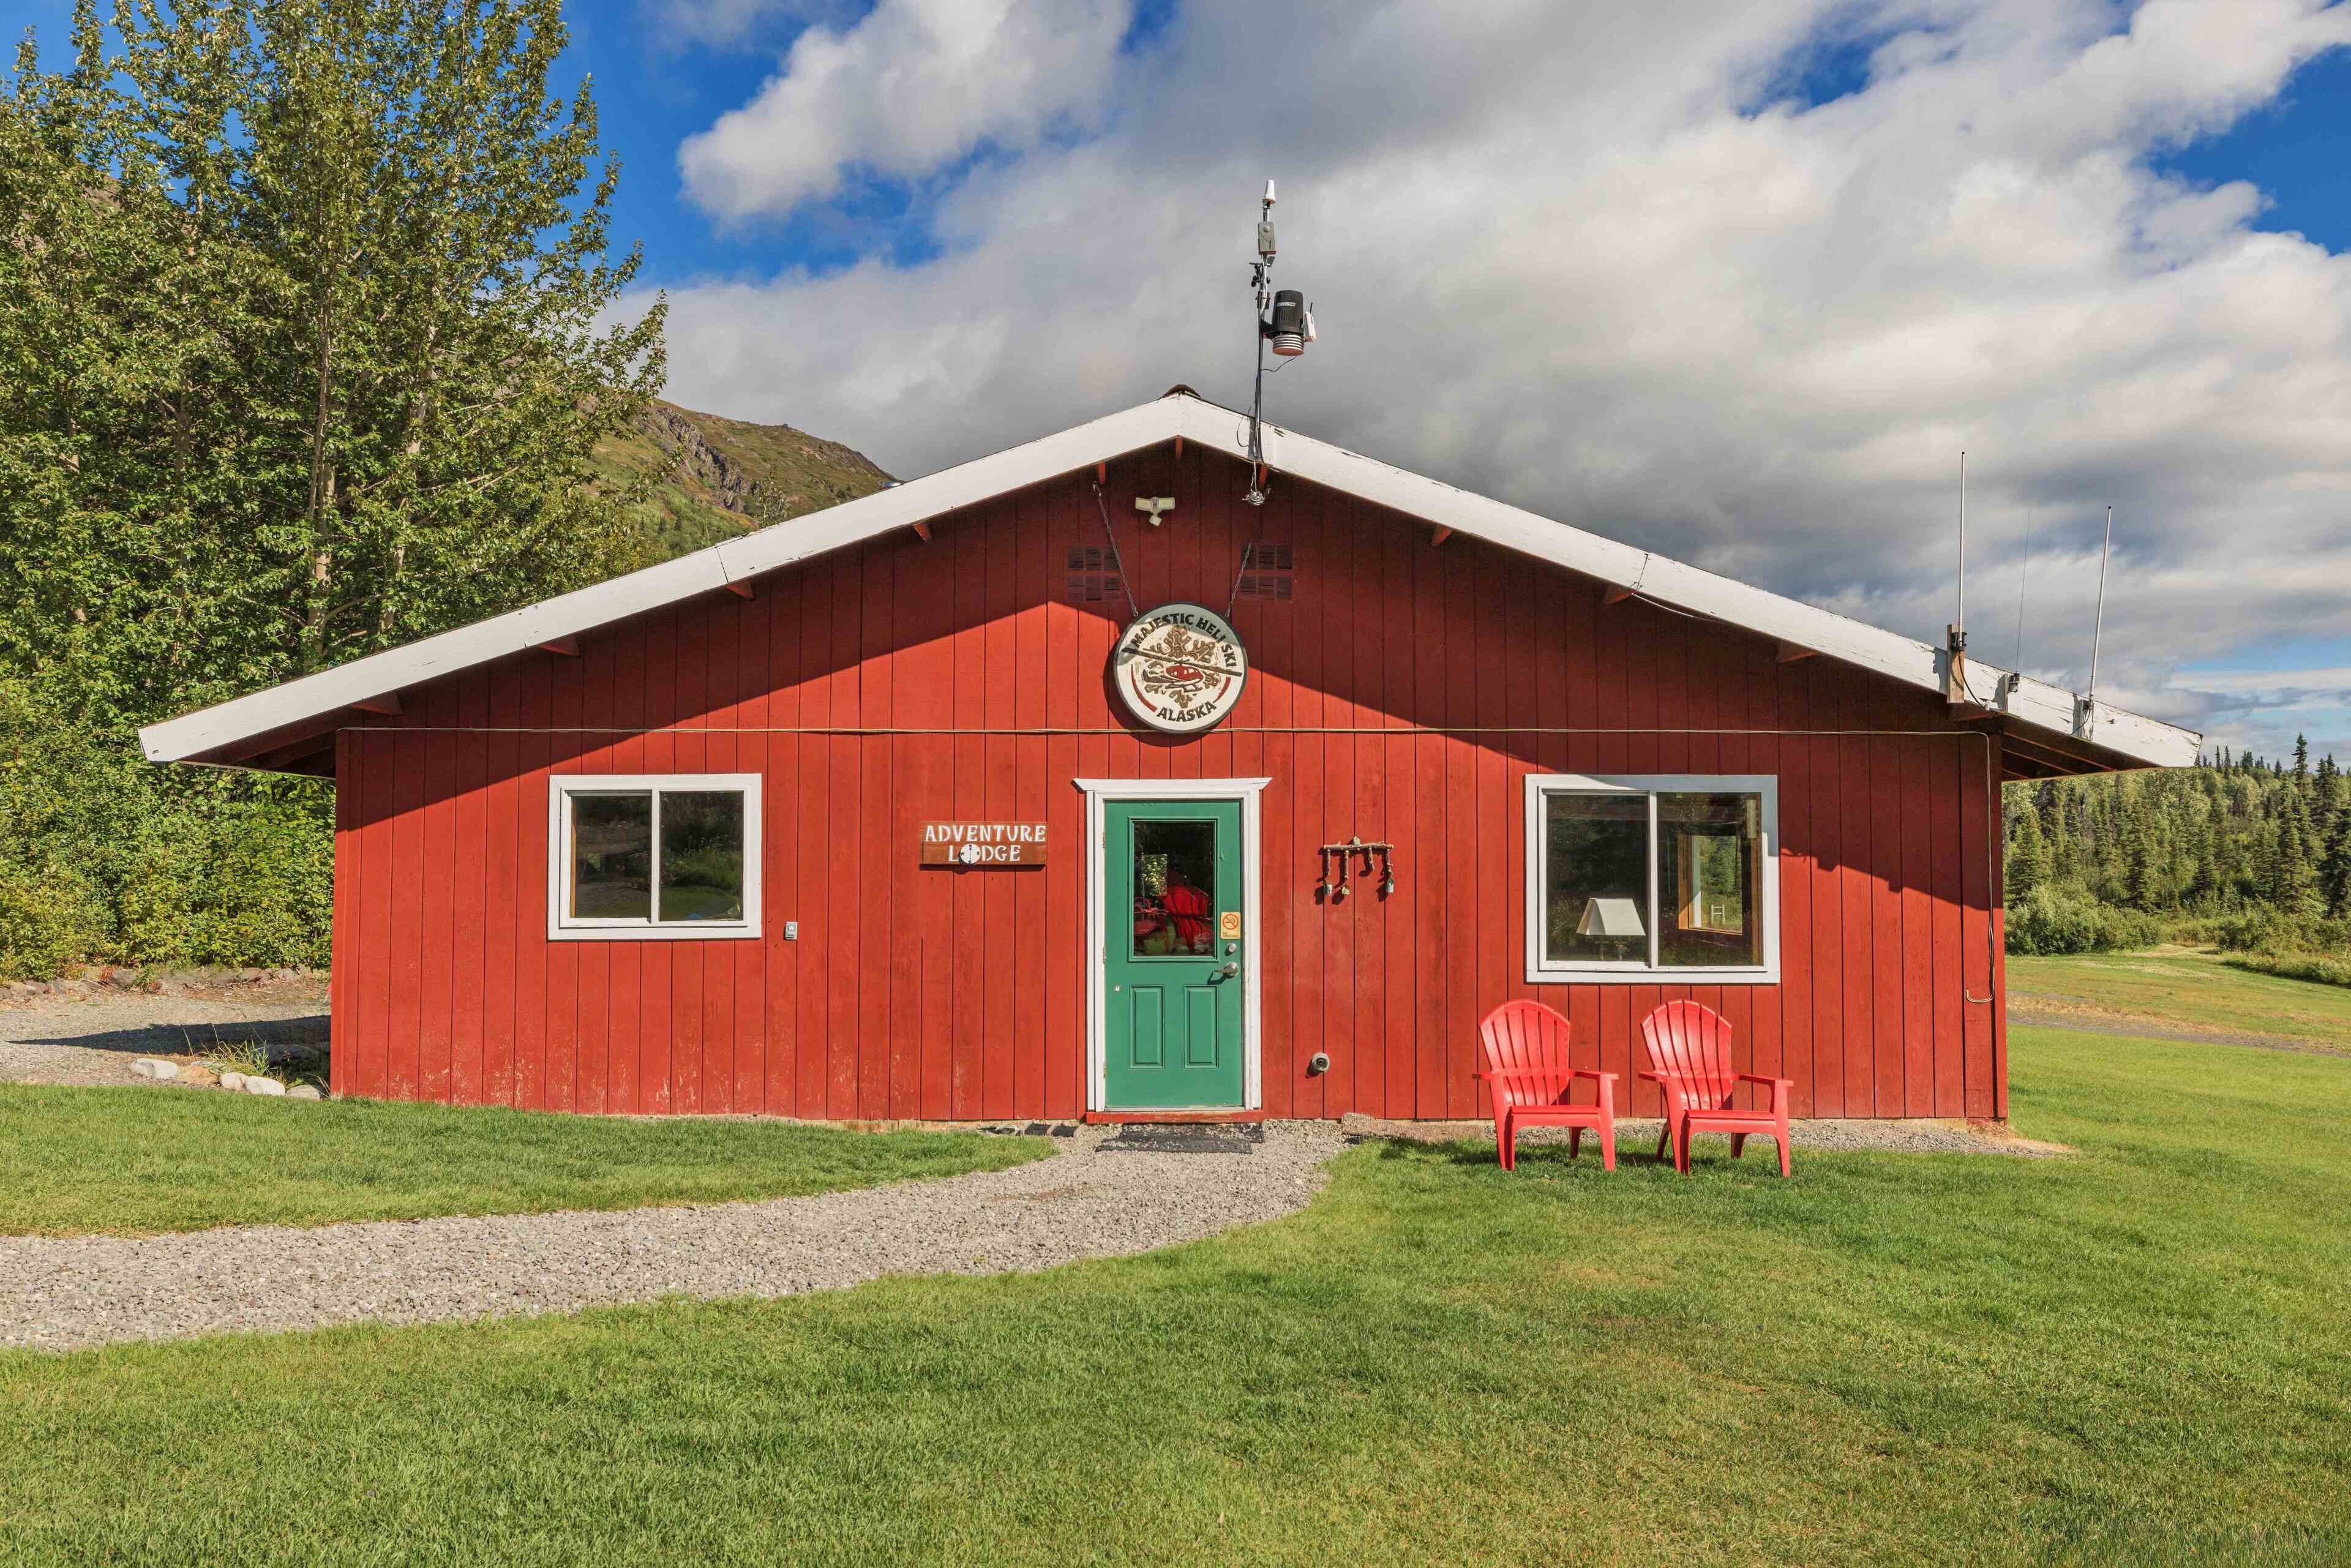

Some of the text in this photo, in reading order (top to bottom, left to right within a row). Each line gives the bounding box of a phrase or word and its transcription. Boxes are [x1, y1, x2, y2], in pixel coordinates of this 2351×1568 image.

[1130, 613, 1237, 667] MAJESTIC HELI SKI
[1157, 701, 1217, 722] ALASKA
[924, 825, 1046, 842] ADVENTURE
[948, 844, 1021, 864] LODGE
